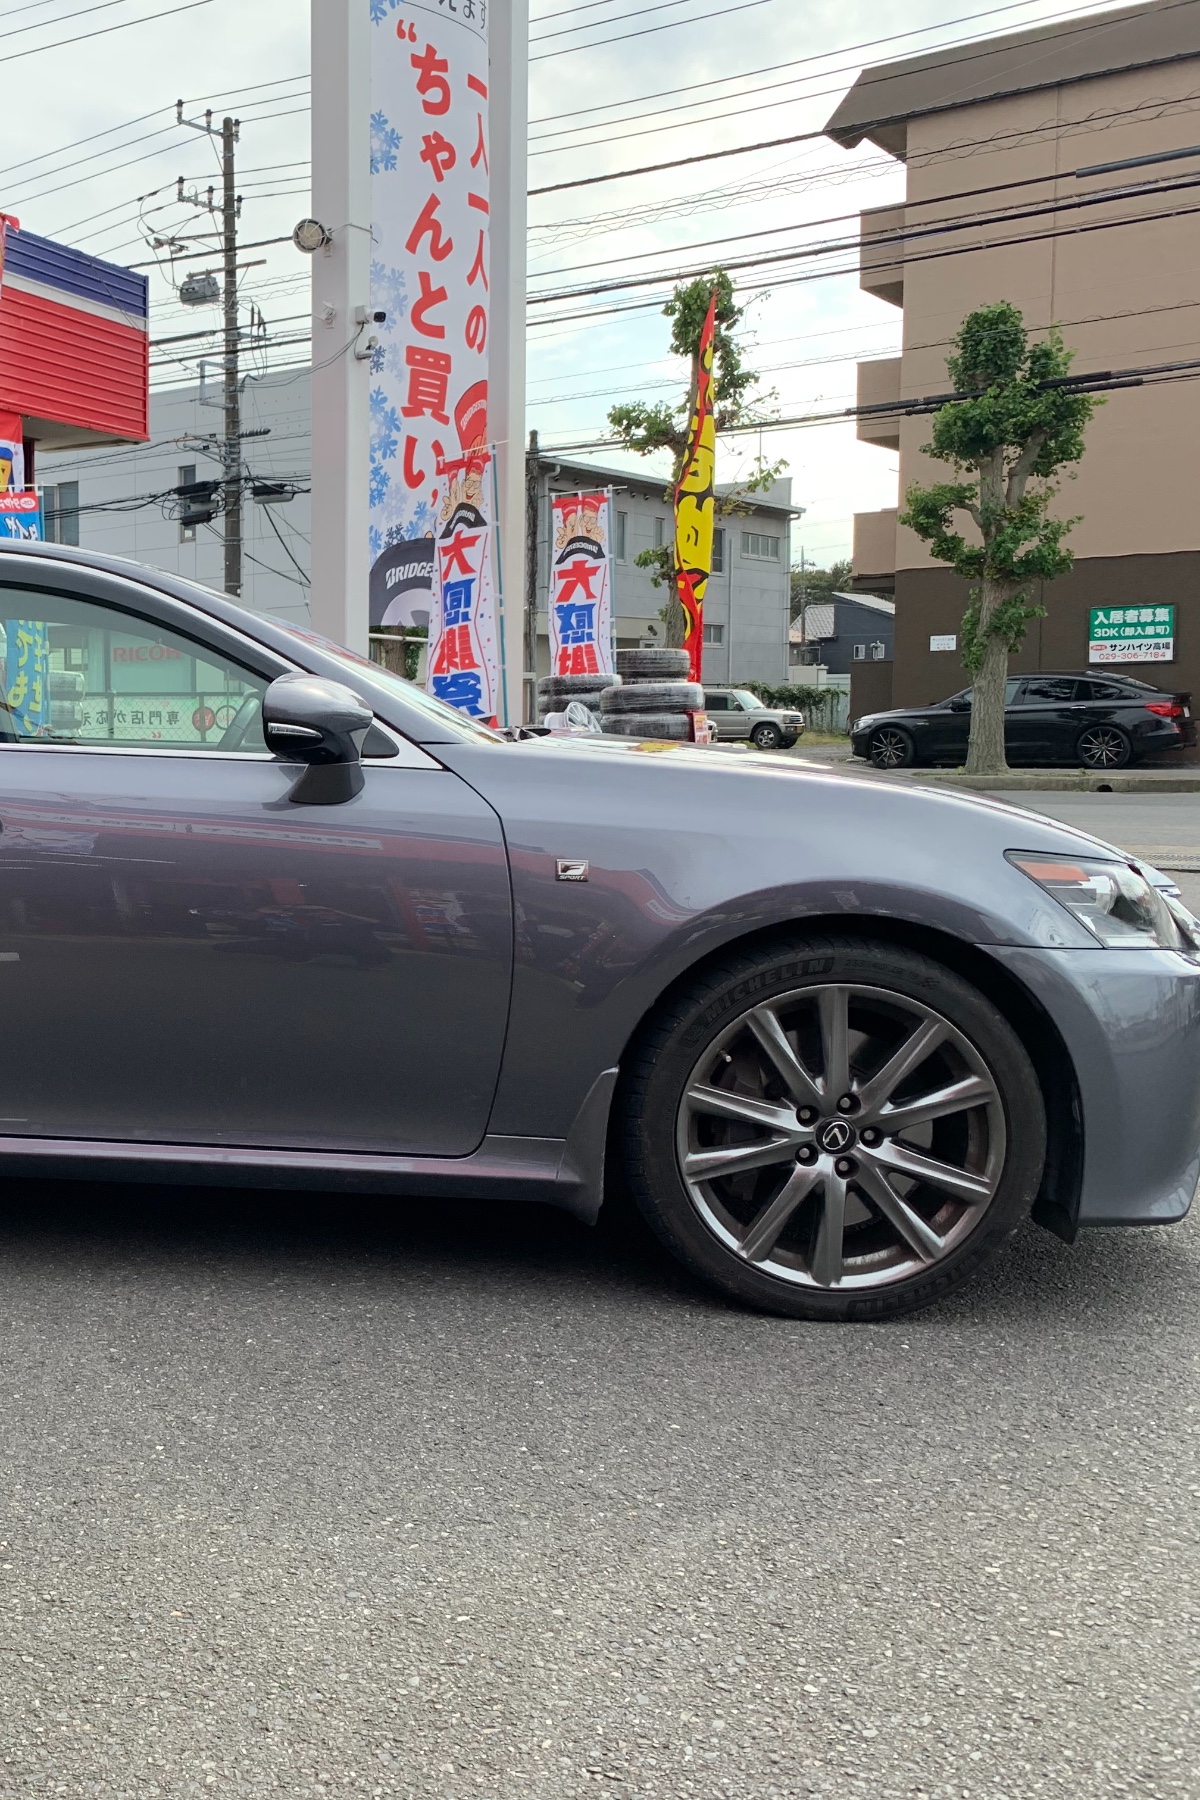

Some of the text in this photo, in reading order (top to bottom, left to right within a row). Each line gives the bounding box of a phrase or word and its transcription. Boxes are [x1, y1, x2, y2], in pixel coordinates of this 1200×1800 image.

[464, 73, 490, 355] 一人一人の
[1093, 608, 1170, 625] 入居者募集
[112, 645, 181, 663] RICOH
[703, 957, 828, 1019] MICHELIN
